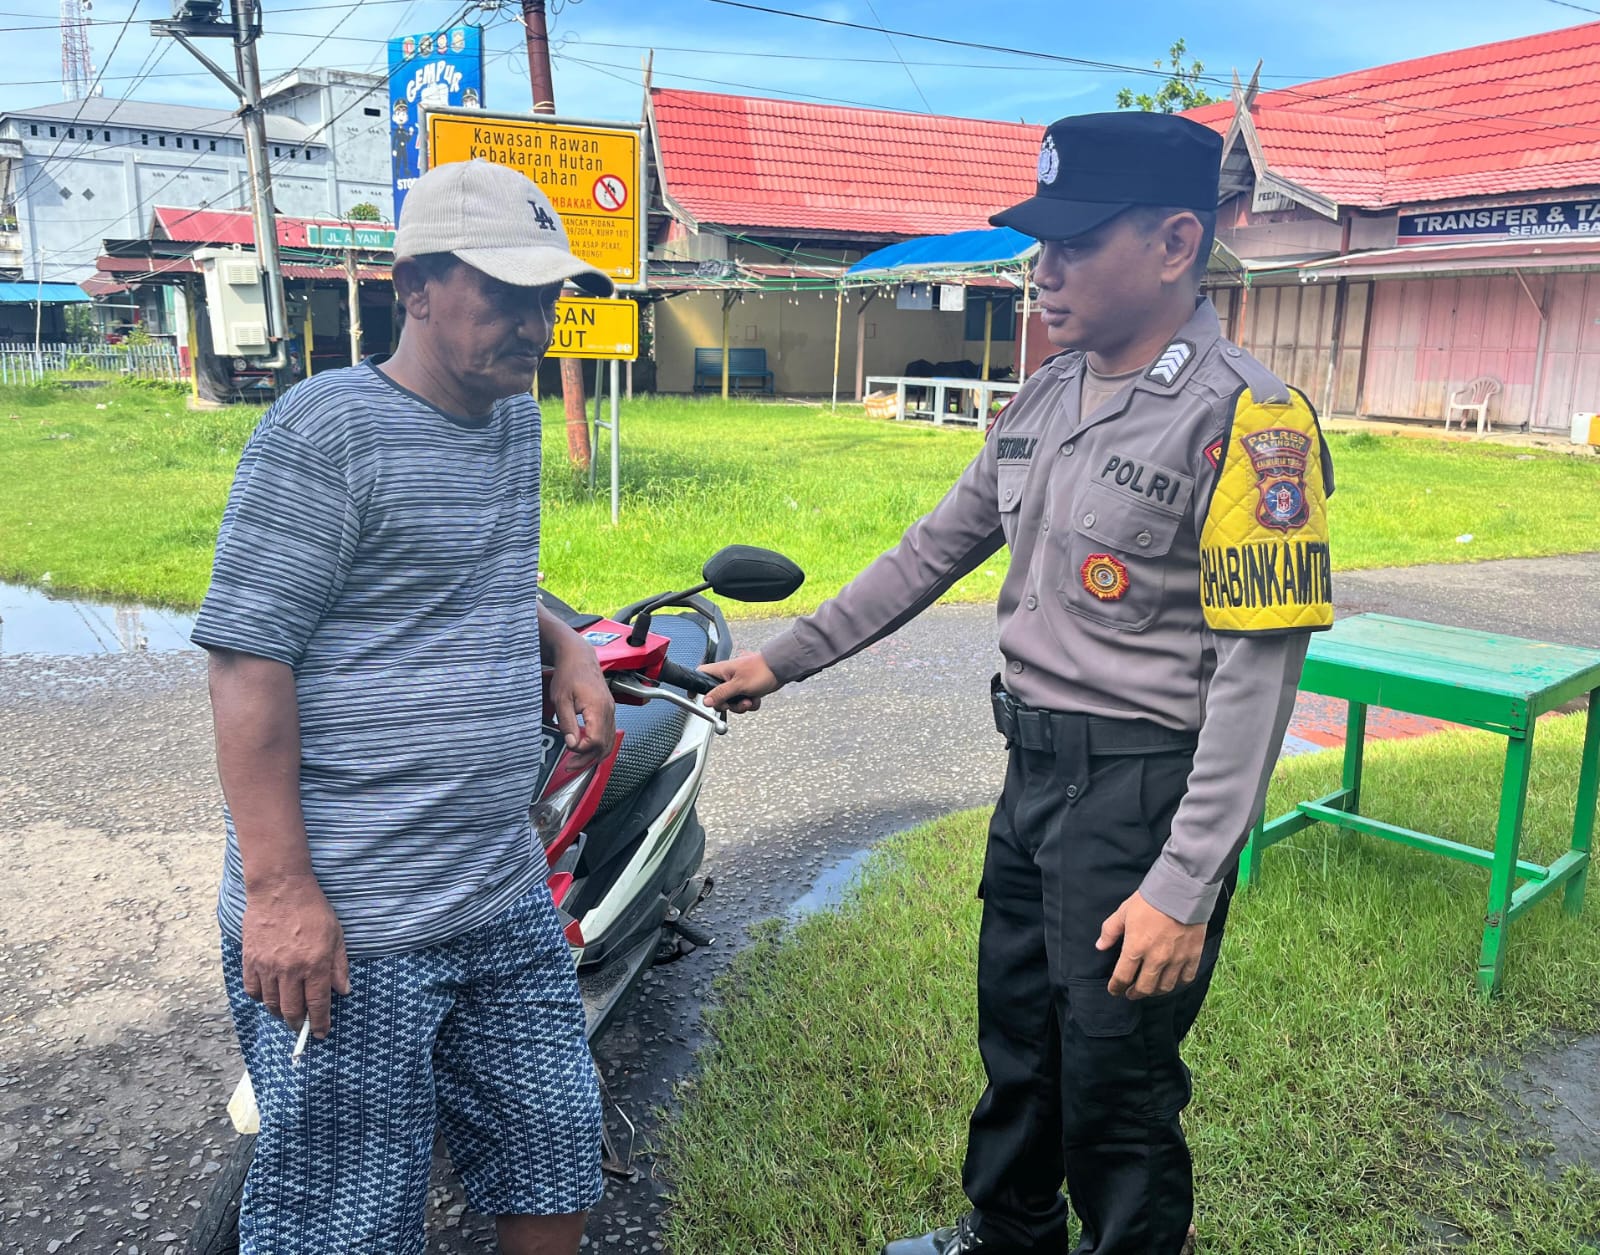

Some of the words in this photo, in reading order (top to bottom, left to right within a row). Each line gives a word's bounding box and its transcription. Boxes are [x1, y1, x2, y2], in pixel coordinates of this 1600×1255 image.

[406, 60, 463, 103] GEMPUR
[474, 127, 542, 149] Kawasan
[550, 134, 599, 153] Rawan
[470, 145, 551, 167] Kebakaran
[559, 154, 603, 171] Hutan
[533, 167, 577, 186] Lahan
[547, 195, 592, 209] MBAKAR
[527, 200, 557, 231] LA
[1414, 208, 1538, 233] TRANSFER
[1546, 206, 1565, 223] &
[356, 233, 381, 245] YANI
[1248, 431, 1306, 447] POLRES
[1101, 455, 1181, 506] POLRI
